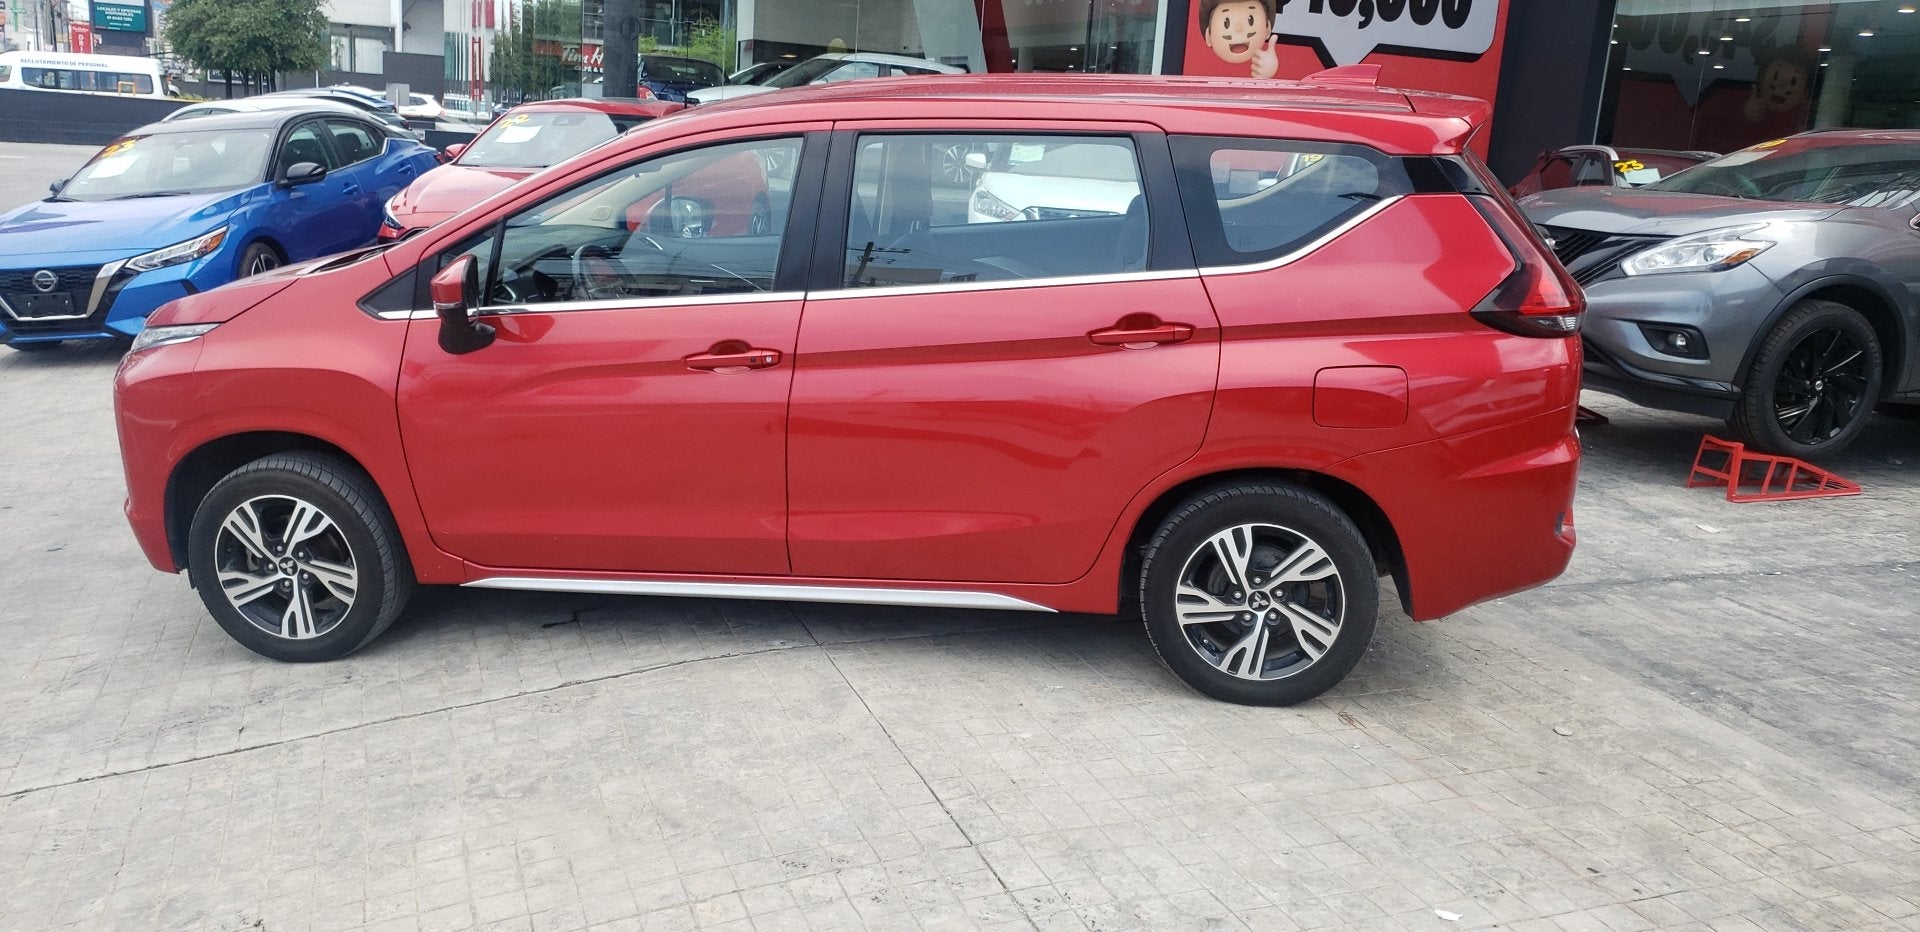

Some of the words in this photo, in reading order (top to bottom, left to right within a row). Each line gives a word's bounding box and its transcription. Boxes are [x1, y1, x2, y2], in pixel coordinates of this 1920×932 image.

[563, 45, 589, 63] Tim
[20, 58, 69, 66] RECLUTAMIENTO
[1614, 160, 1644, 172] 23
